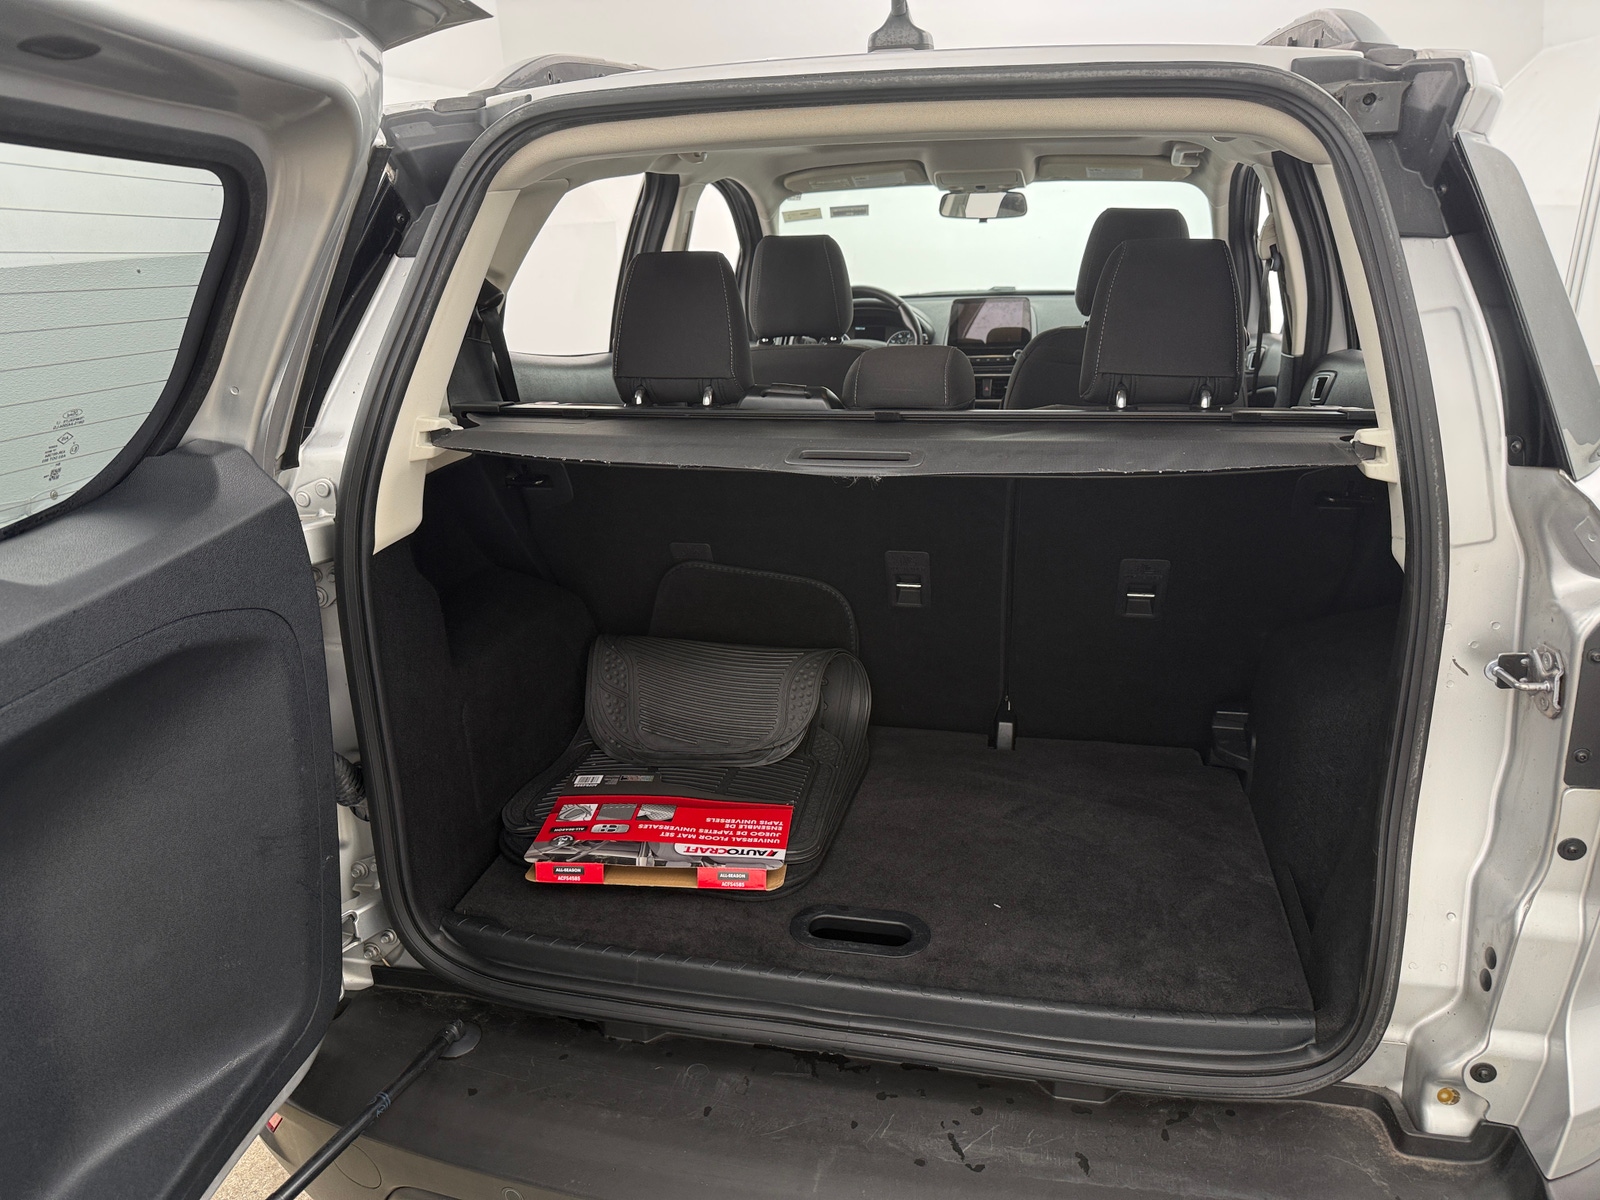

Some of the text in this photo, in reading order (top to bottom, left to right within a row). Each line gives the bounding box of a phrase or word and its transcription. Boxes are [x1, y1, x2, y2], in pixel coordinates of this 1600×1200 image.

[705, 817, 757, 825] UNIVERSELS
[638, 823, 697, 833] UNIVERSALES
[698, 834, 729, 842] FLOOR
[731, 836, 780, 844] UNIVERSAL
[684, 846, 768, 857] AUTOCRAFT
